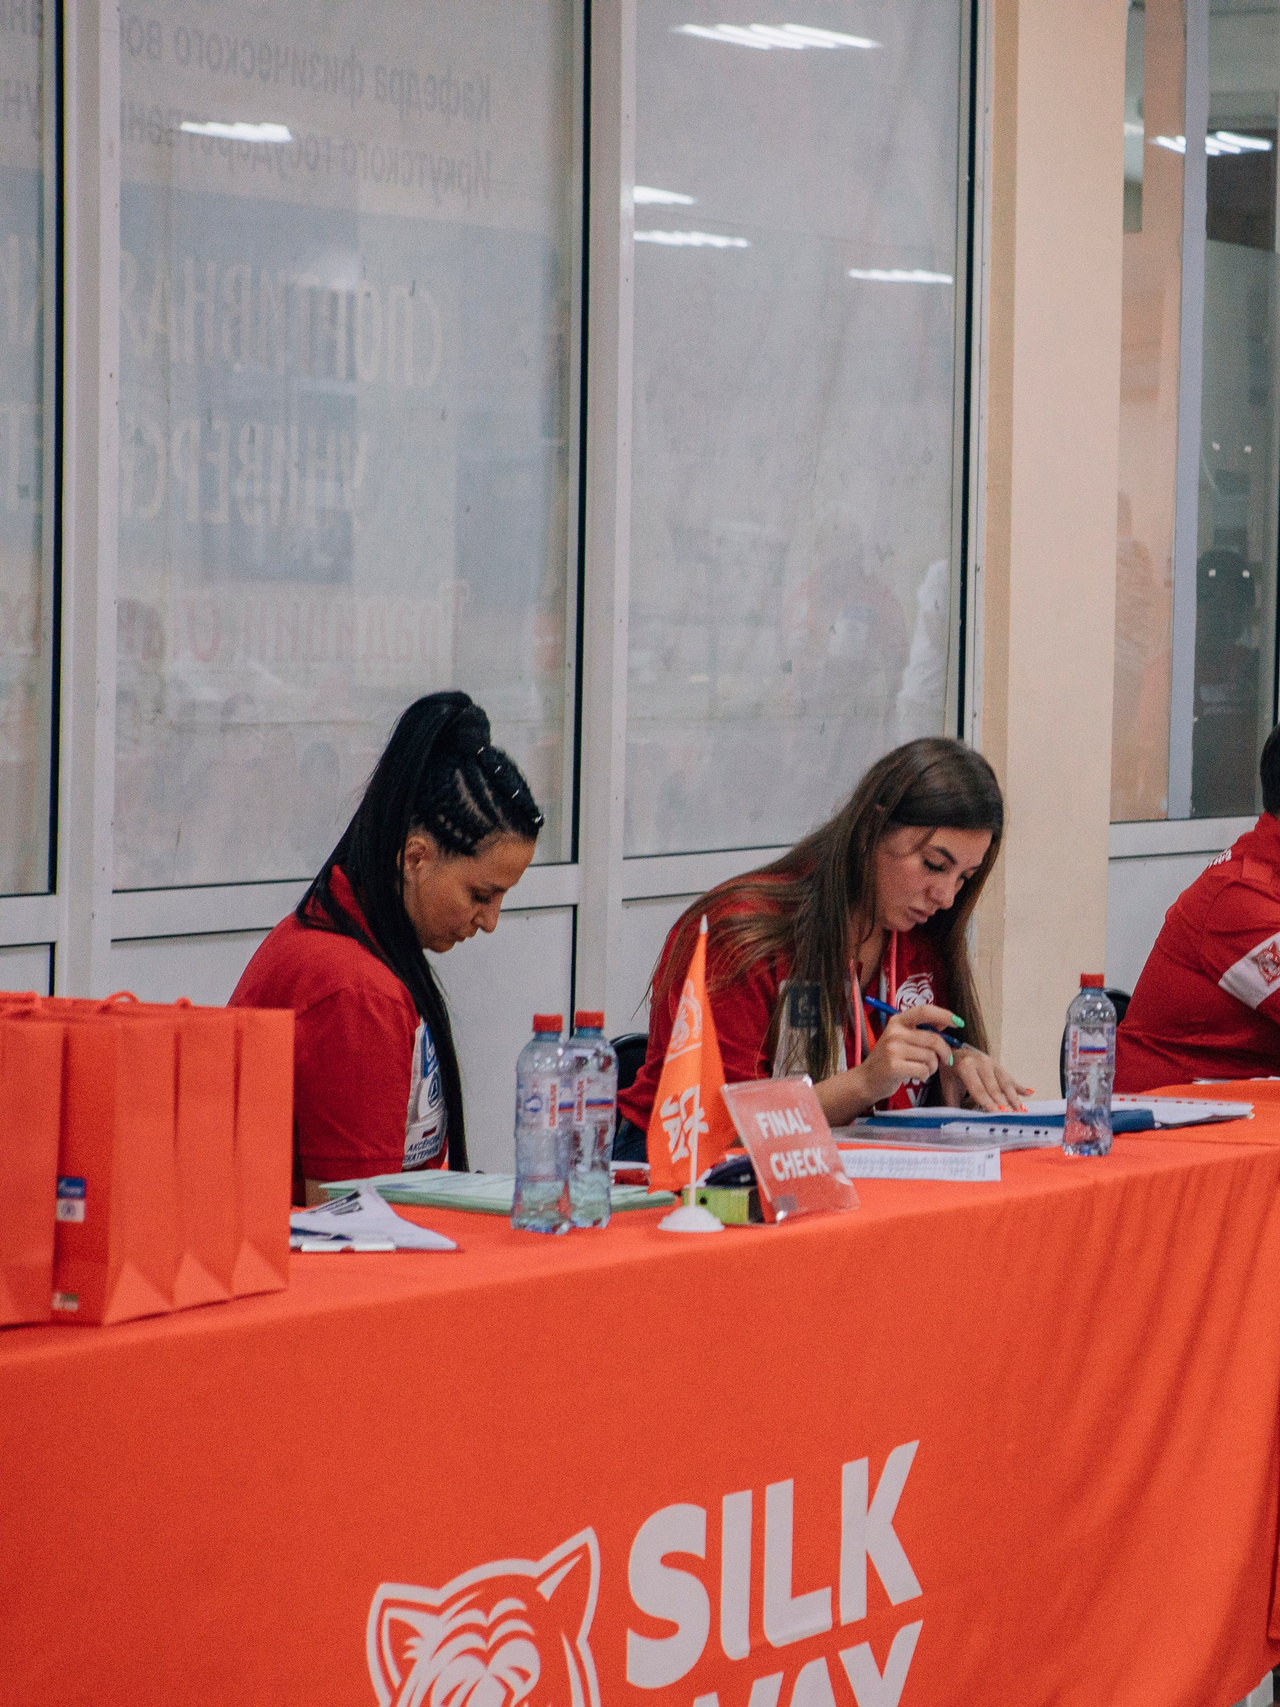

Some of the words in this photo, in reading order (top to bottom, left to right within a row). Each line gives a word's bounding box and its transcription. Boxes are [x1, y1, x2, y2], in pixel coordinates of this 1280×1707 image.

[754, 1106, 813, 1139] FINAL
[769, 1147, 829, 1181] CHECK
[626, 1440, 923, 1689] SILK
